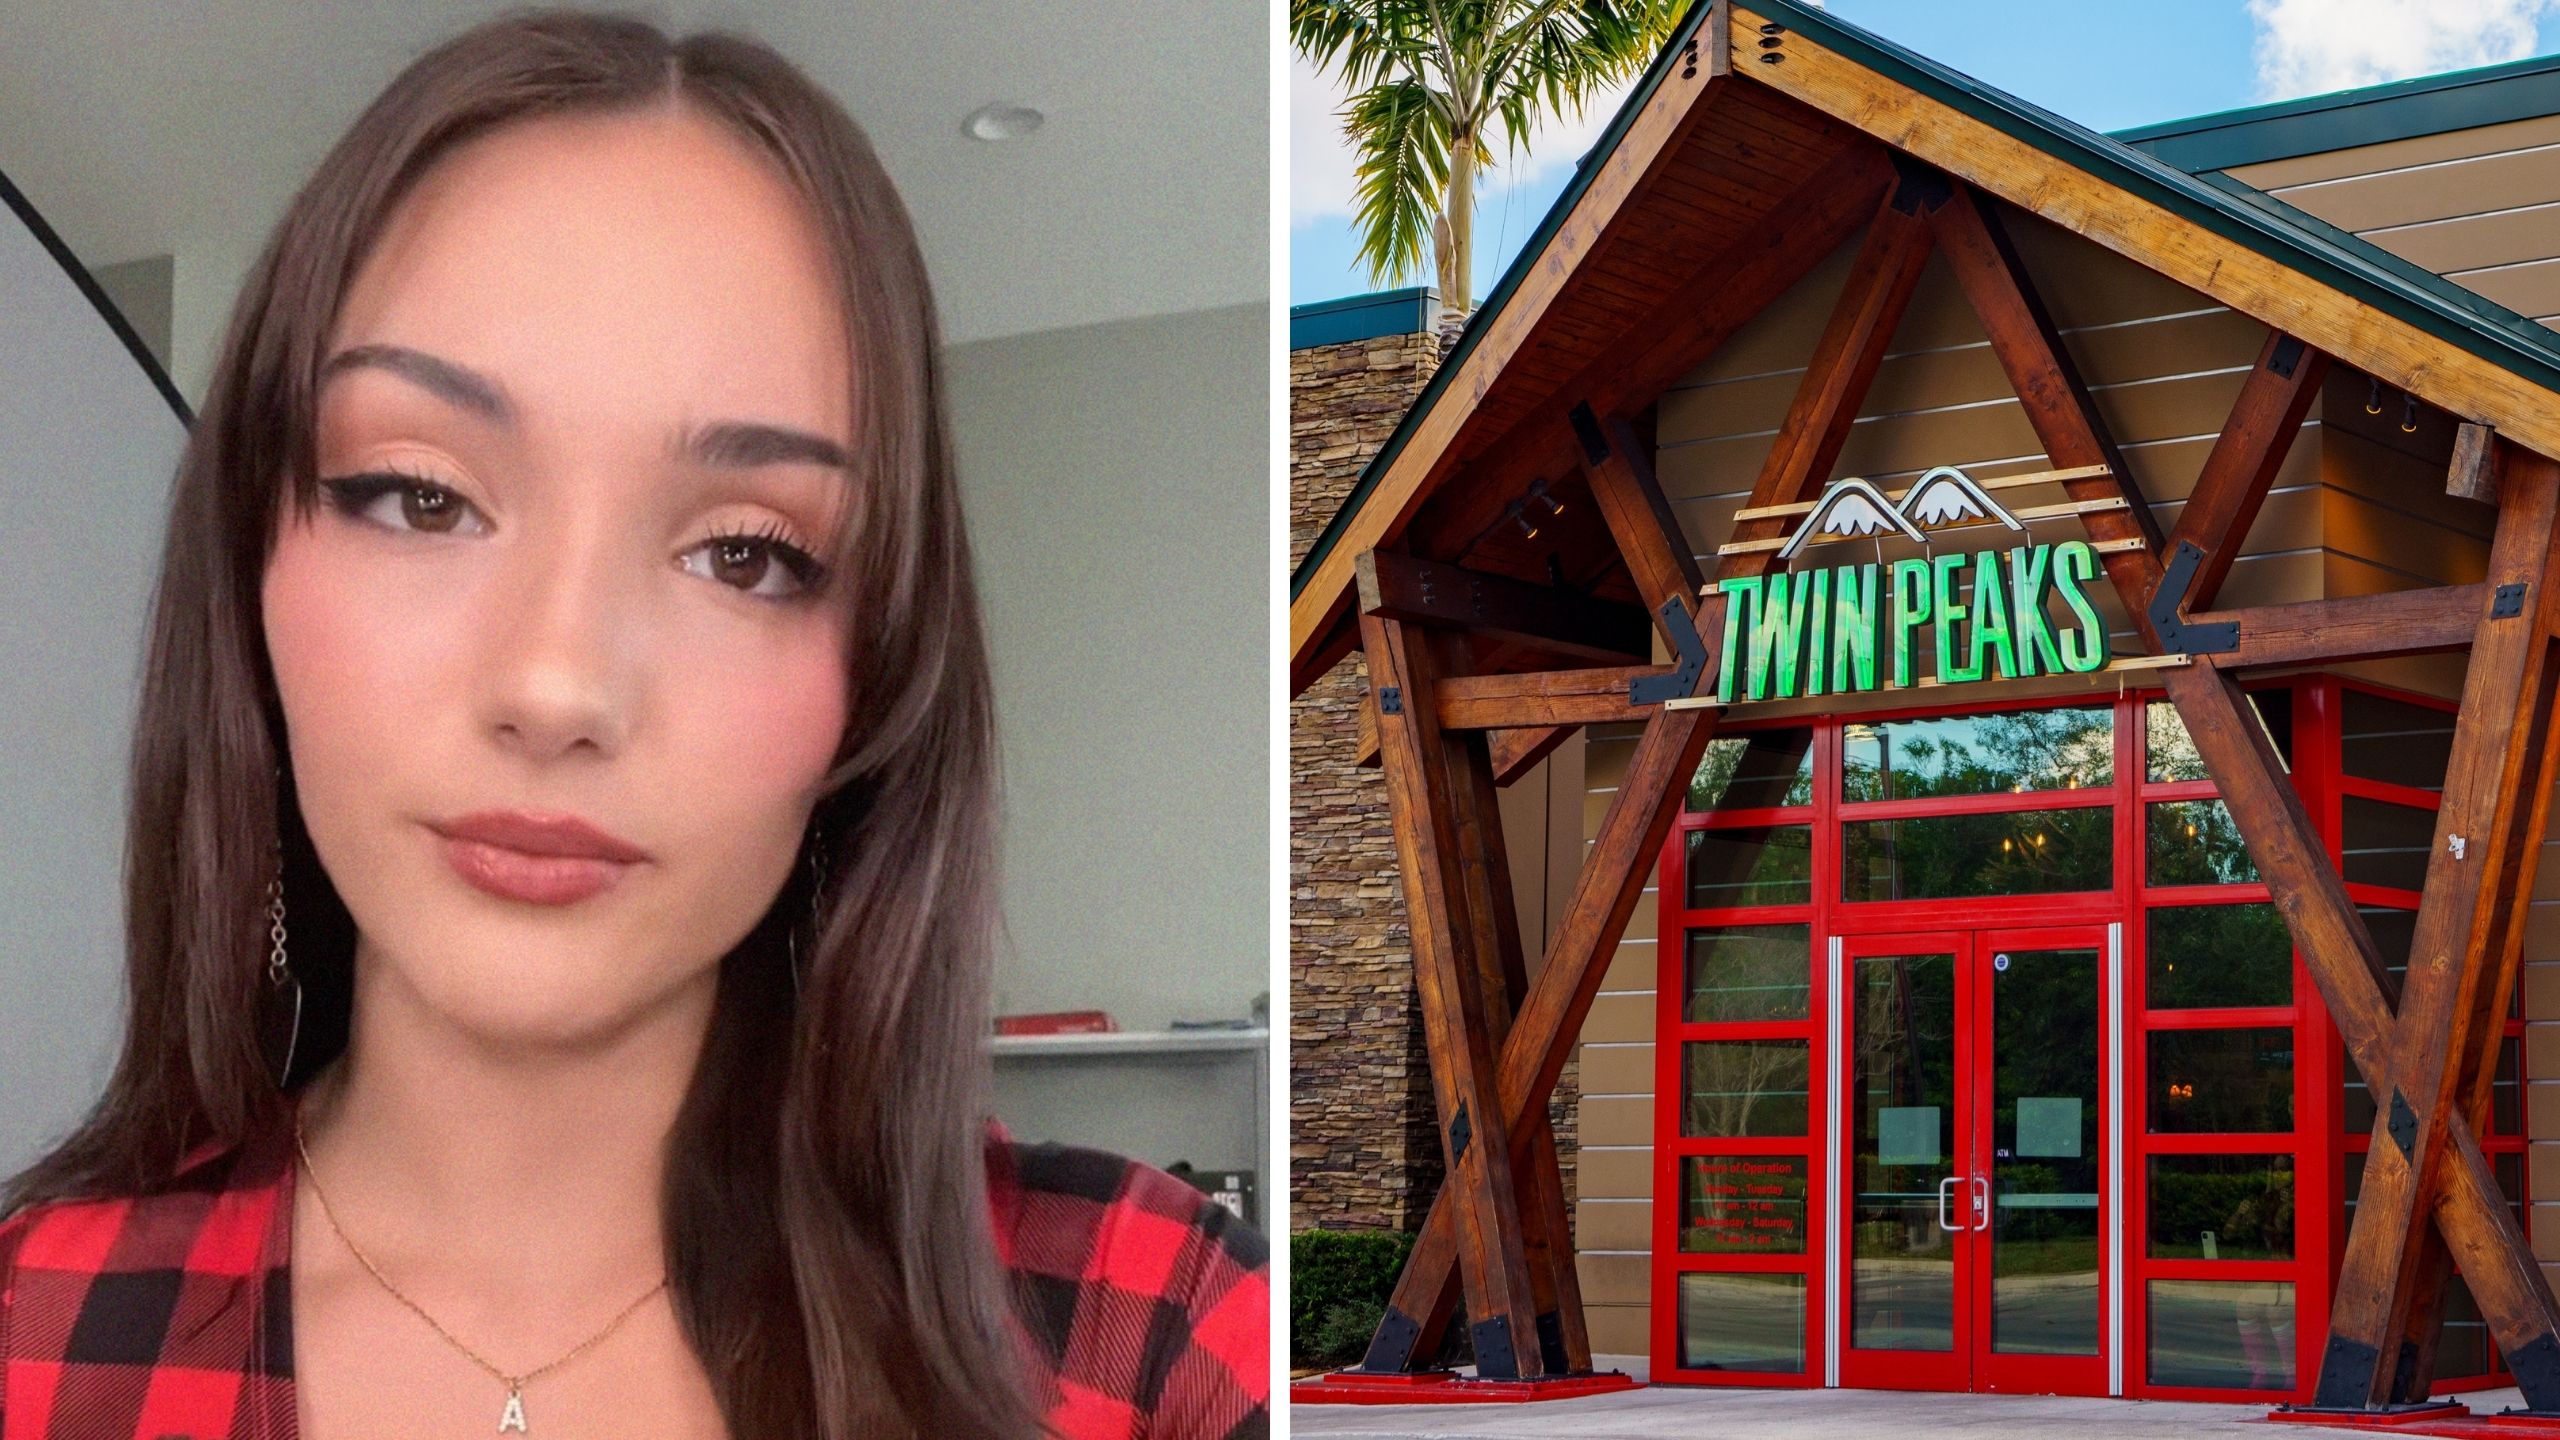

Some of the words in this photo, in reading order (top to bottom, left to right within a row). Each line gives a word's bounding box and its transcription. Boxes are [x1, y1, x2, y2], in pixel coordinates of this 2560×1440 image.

[1717, 563, 1886, 702] TWIN
[1893, 541, 2110, 688] PEAKS
[1997, 1148, 2009, 1157] ATM
[1730, 1163, 1741, 1173] of
[1743, 1162, 1793, 1175] Operation
[1746, 1183, 1783, 1195] Tuesday
[1695, 1216, 1745, 1229] Wednesday
[1752, 1217, 1793, 1229] Saturday
[499, 1390, 527, 1433] A
